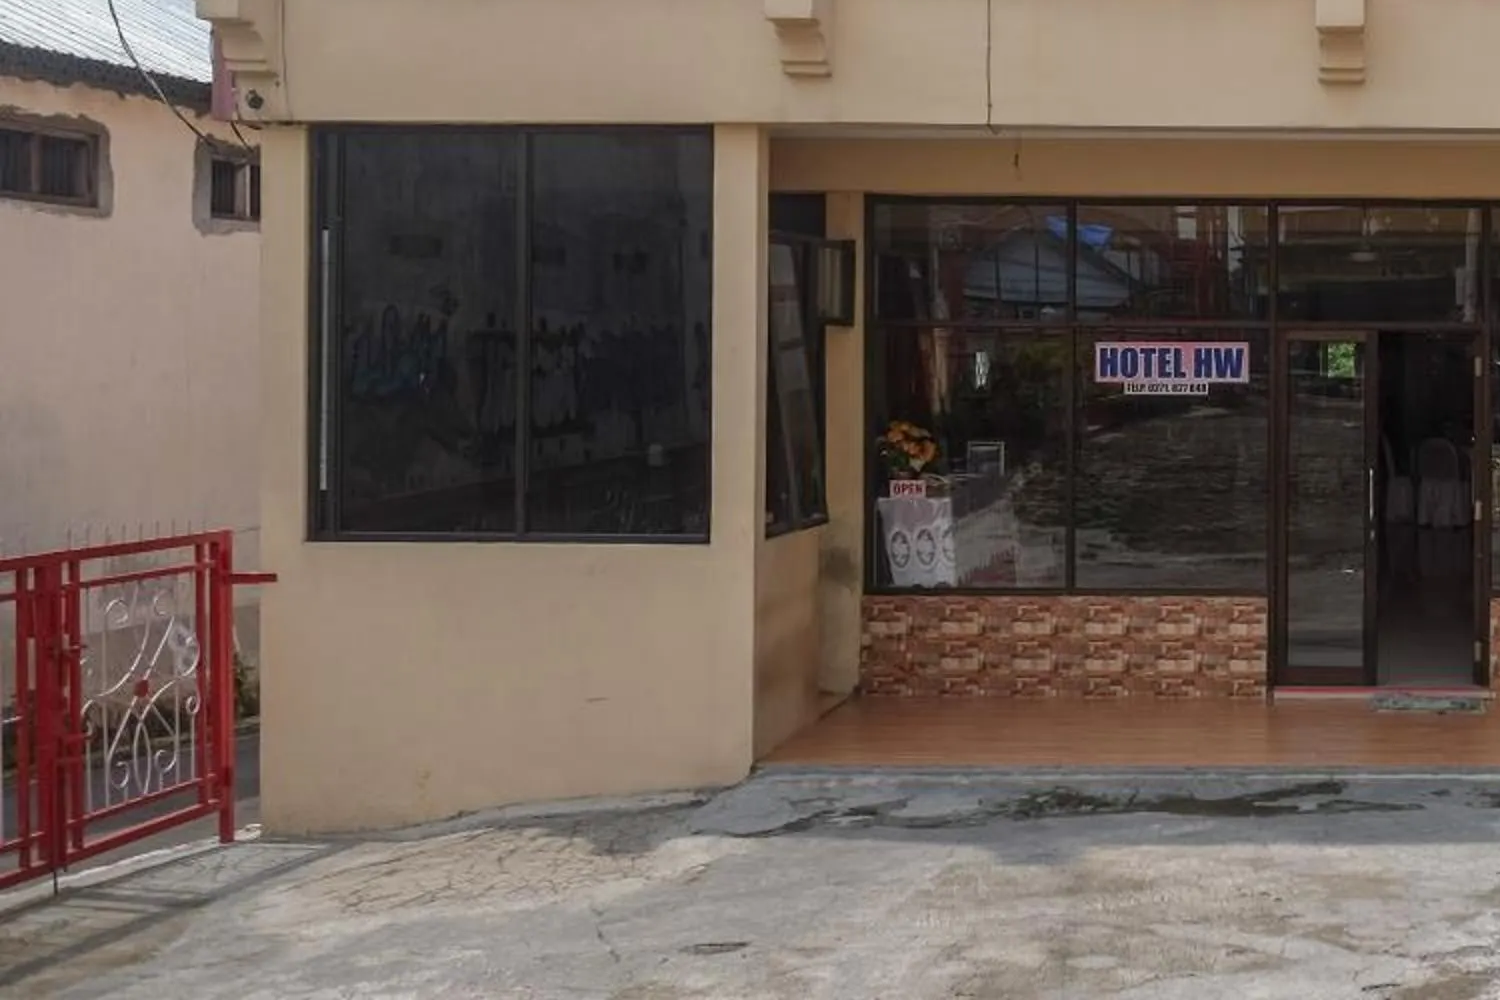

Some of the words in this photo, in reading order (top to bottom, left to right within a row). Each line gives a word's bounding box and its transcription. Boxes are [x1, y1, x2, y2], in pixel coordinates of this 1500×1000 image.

[1100, 348, 1187, 378] HOTEL
[1194, 348, 1244, 378] HW
[894, 483, 923, 495] OPEN
